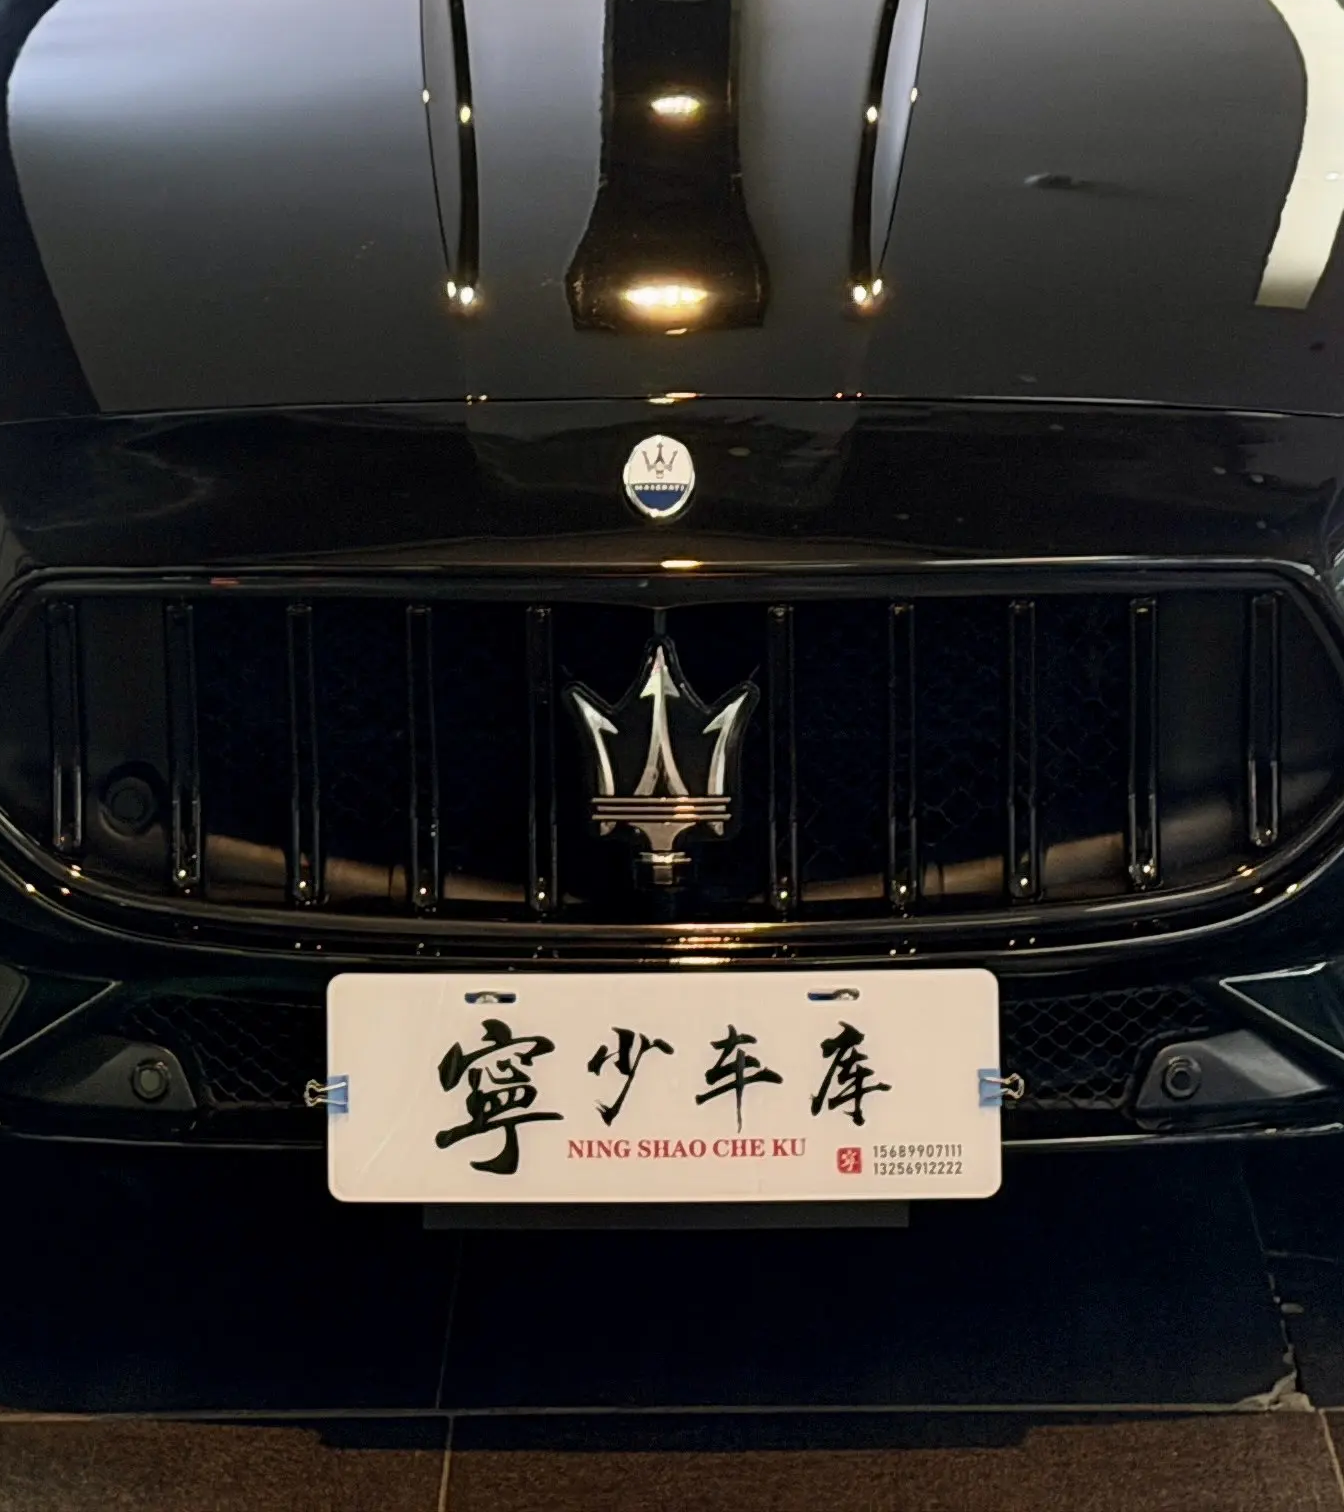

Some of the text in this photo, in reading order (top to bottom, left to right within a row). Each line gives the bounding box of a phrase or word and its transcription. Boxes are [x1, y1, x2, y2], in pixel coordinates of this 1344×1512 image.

[567, 1137, 806, 1159] NING SHAO CHE KU
[873, 1143, 962, 1159] 15689907111
[873, 1161, 962, 1175] 13256912222
